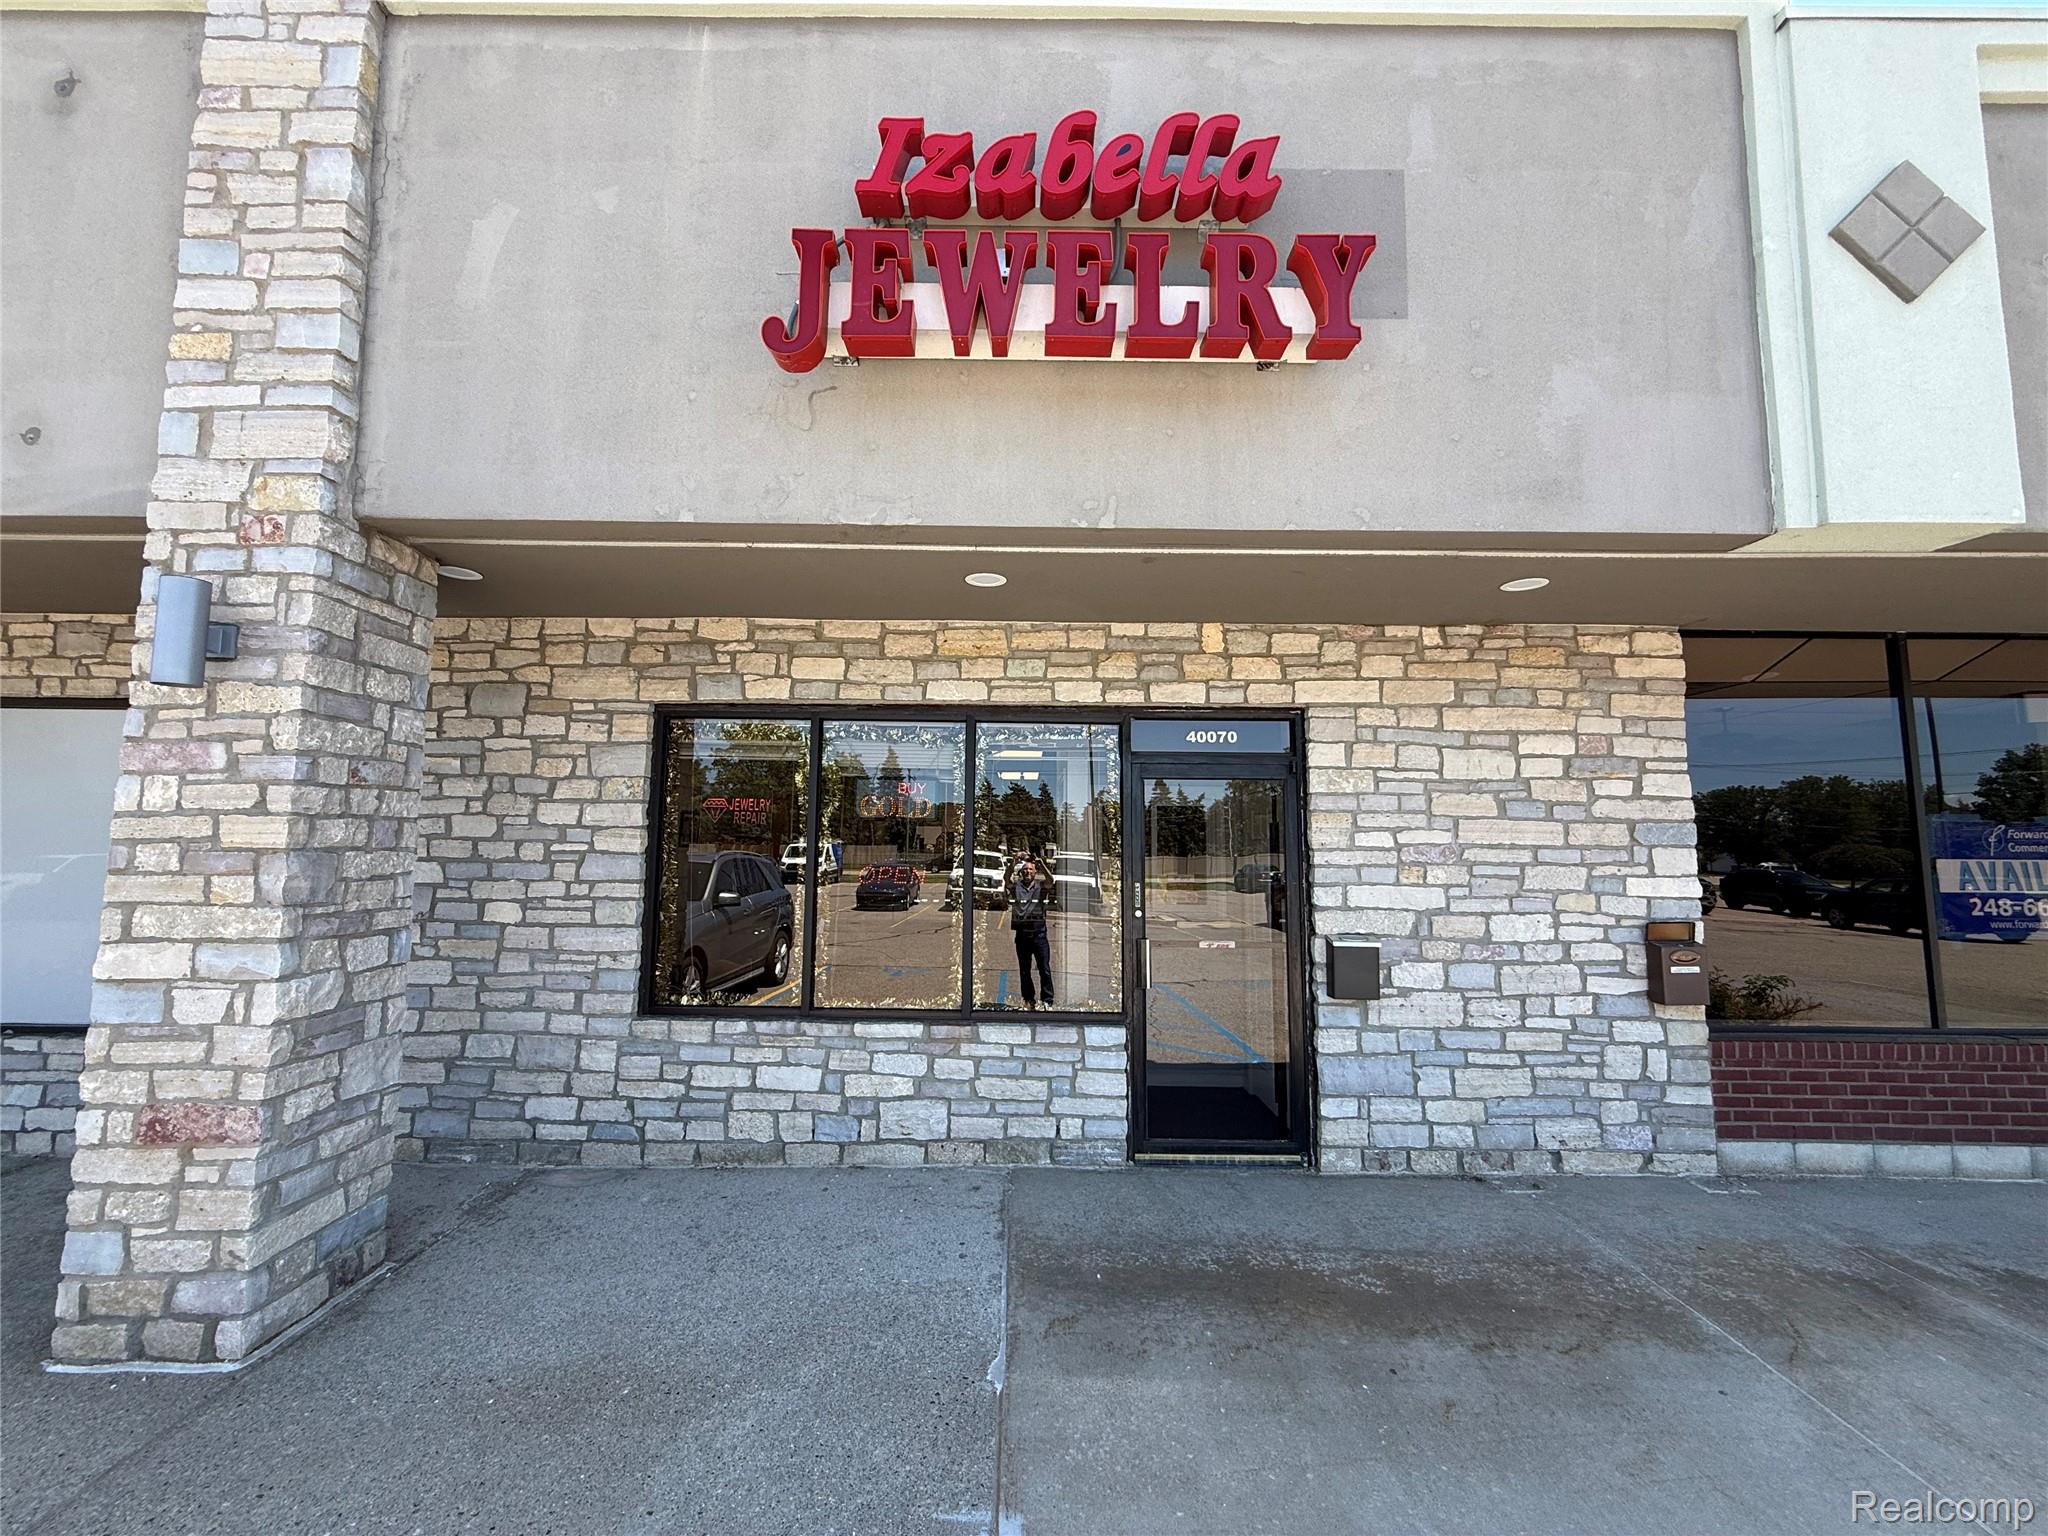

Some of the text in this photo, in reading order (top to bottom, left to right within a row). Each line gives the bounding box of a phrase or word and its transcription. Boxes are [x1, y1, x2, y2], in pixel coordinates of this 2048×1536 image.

[855, 109, 1283, 221] Izabella
[762, 227, 1377, 373] JEWELRY
[1185, 730, 1238, 743] 40070
[897, 782, 927, 794] BUY
[729, 798, 771, 812] JEWELRY
[860, 795, 932, 818] GOLD
[733, 811, 767, 825] REPAIR
[859, 865, 926, 885] OPEN
[1959, 861, 2048, 891] AVAIL
[1968, 897, 2048, 917] 248-66
